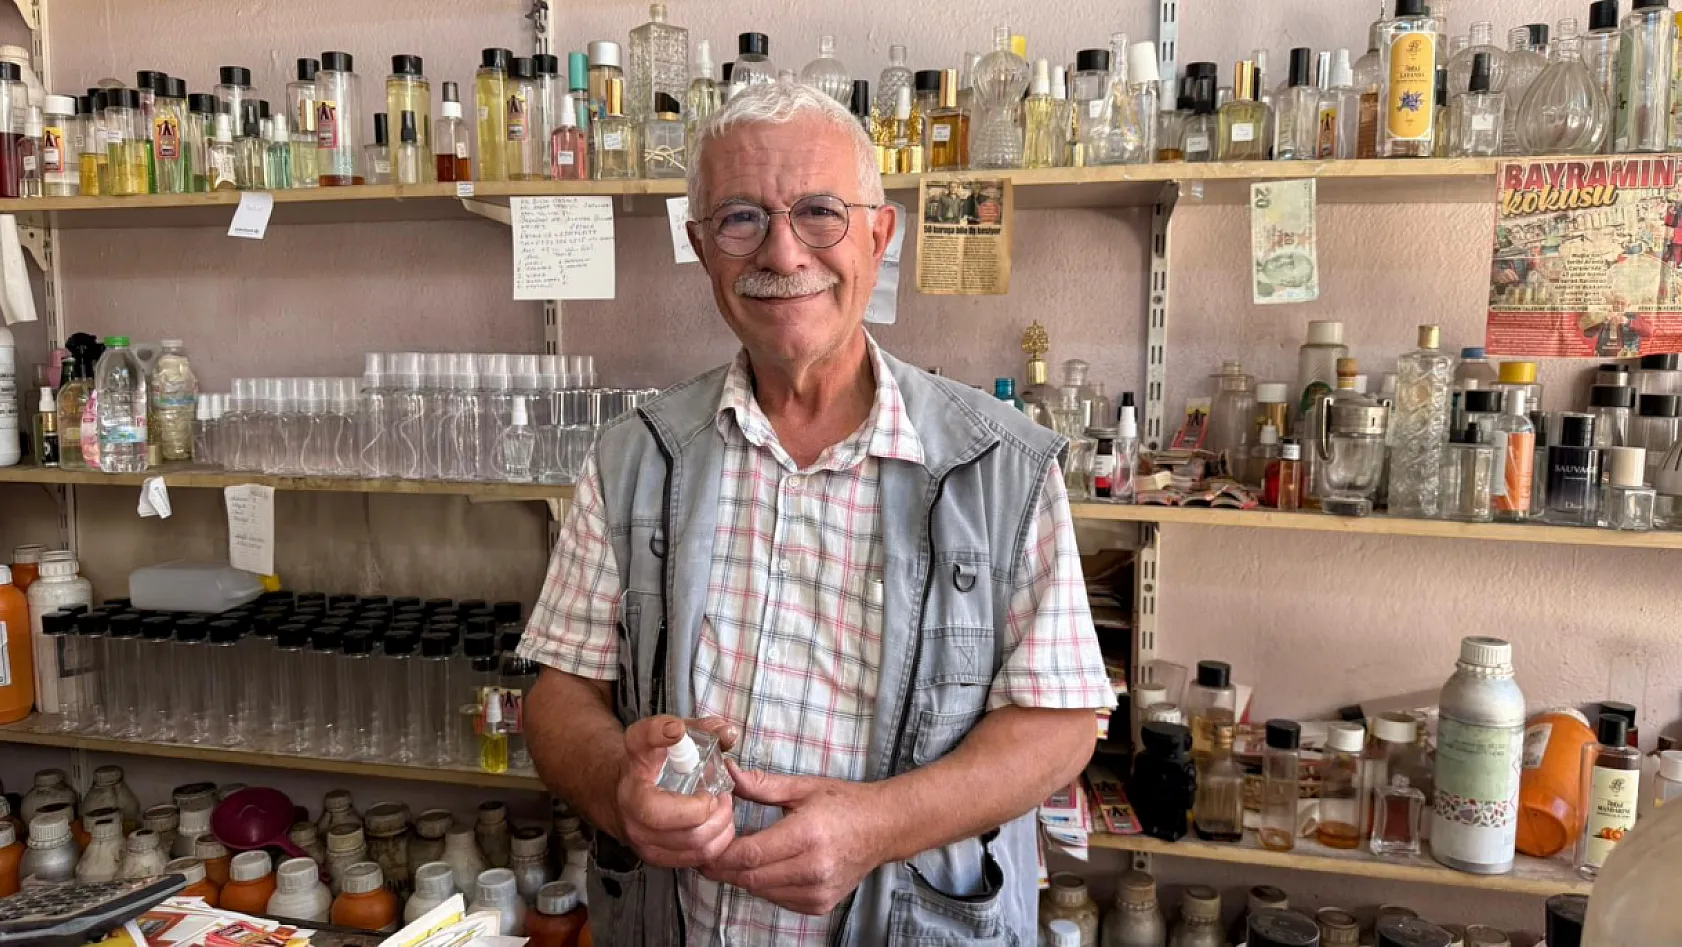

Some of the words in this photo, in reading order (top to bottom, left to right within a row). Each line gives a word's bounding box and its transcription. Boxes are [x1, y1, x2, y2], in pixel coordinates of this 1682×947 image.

[1503, 159, 1675, 190] BAYRAMIN
[1256, 188, 1271, 208] 20
[1502, 185, 1618, 216] kokusu
[1554, 464, 1599, 474] SAUVAGE
